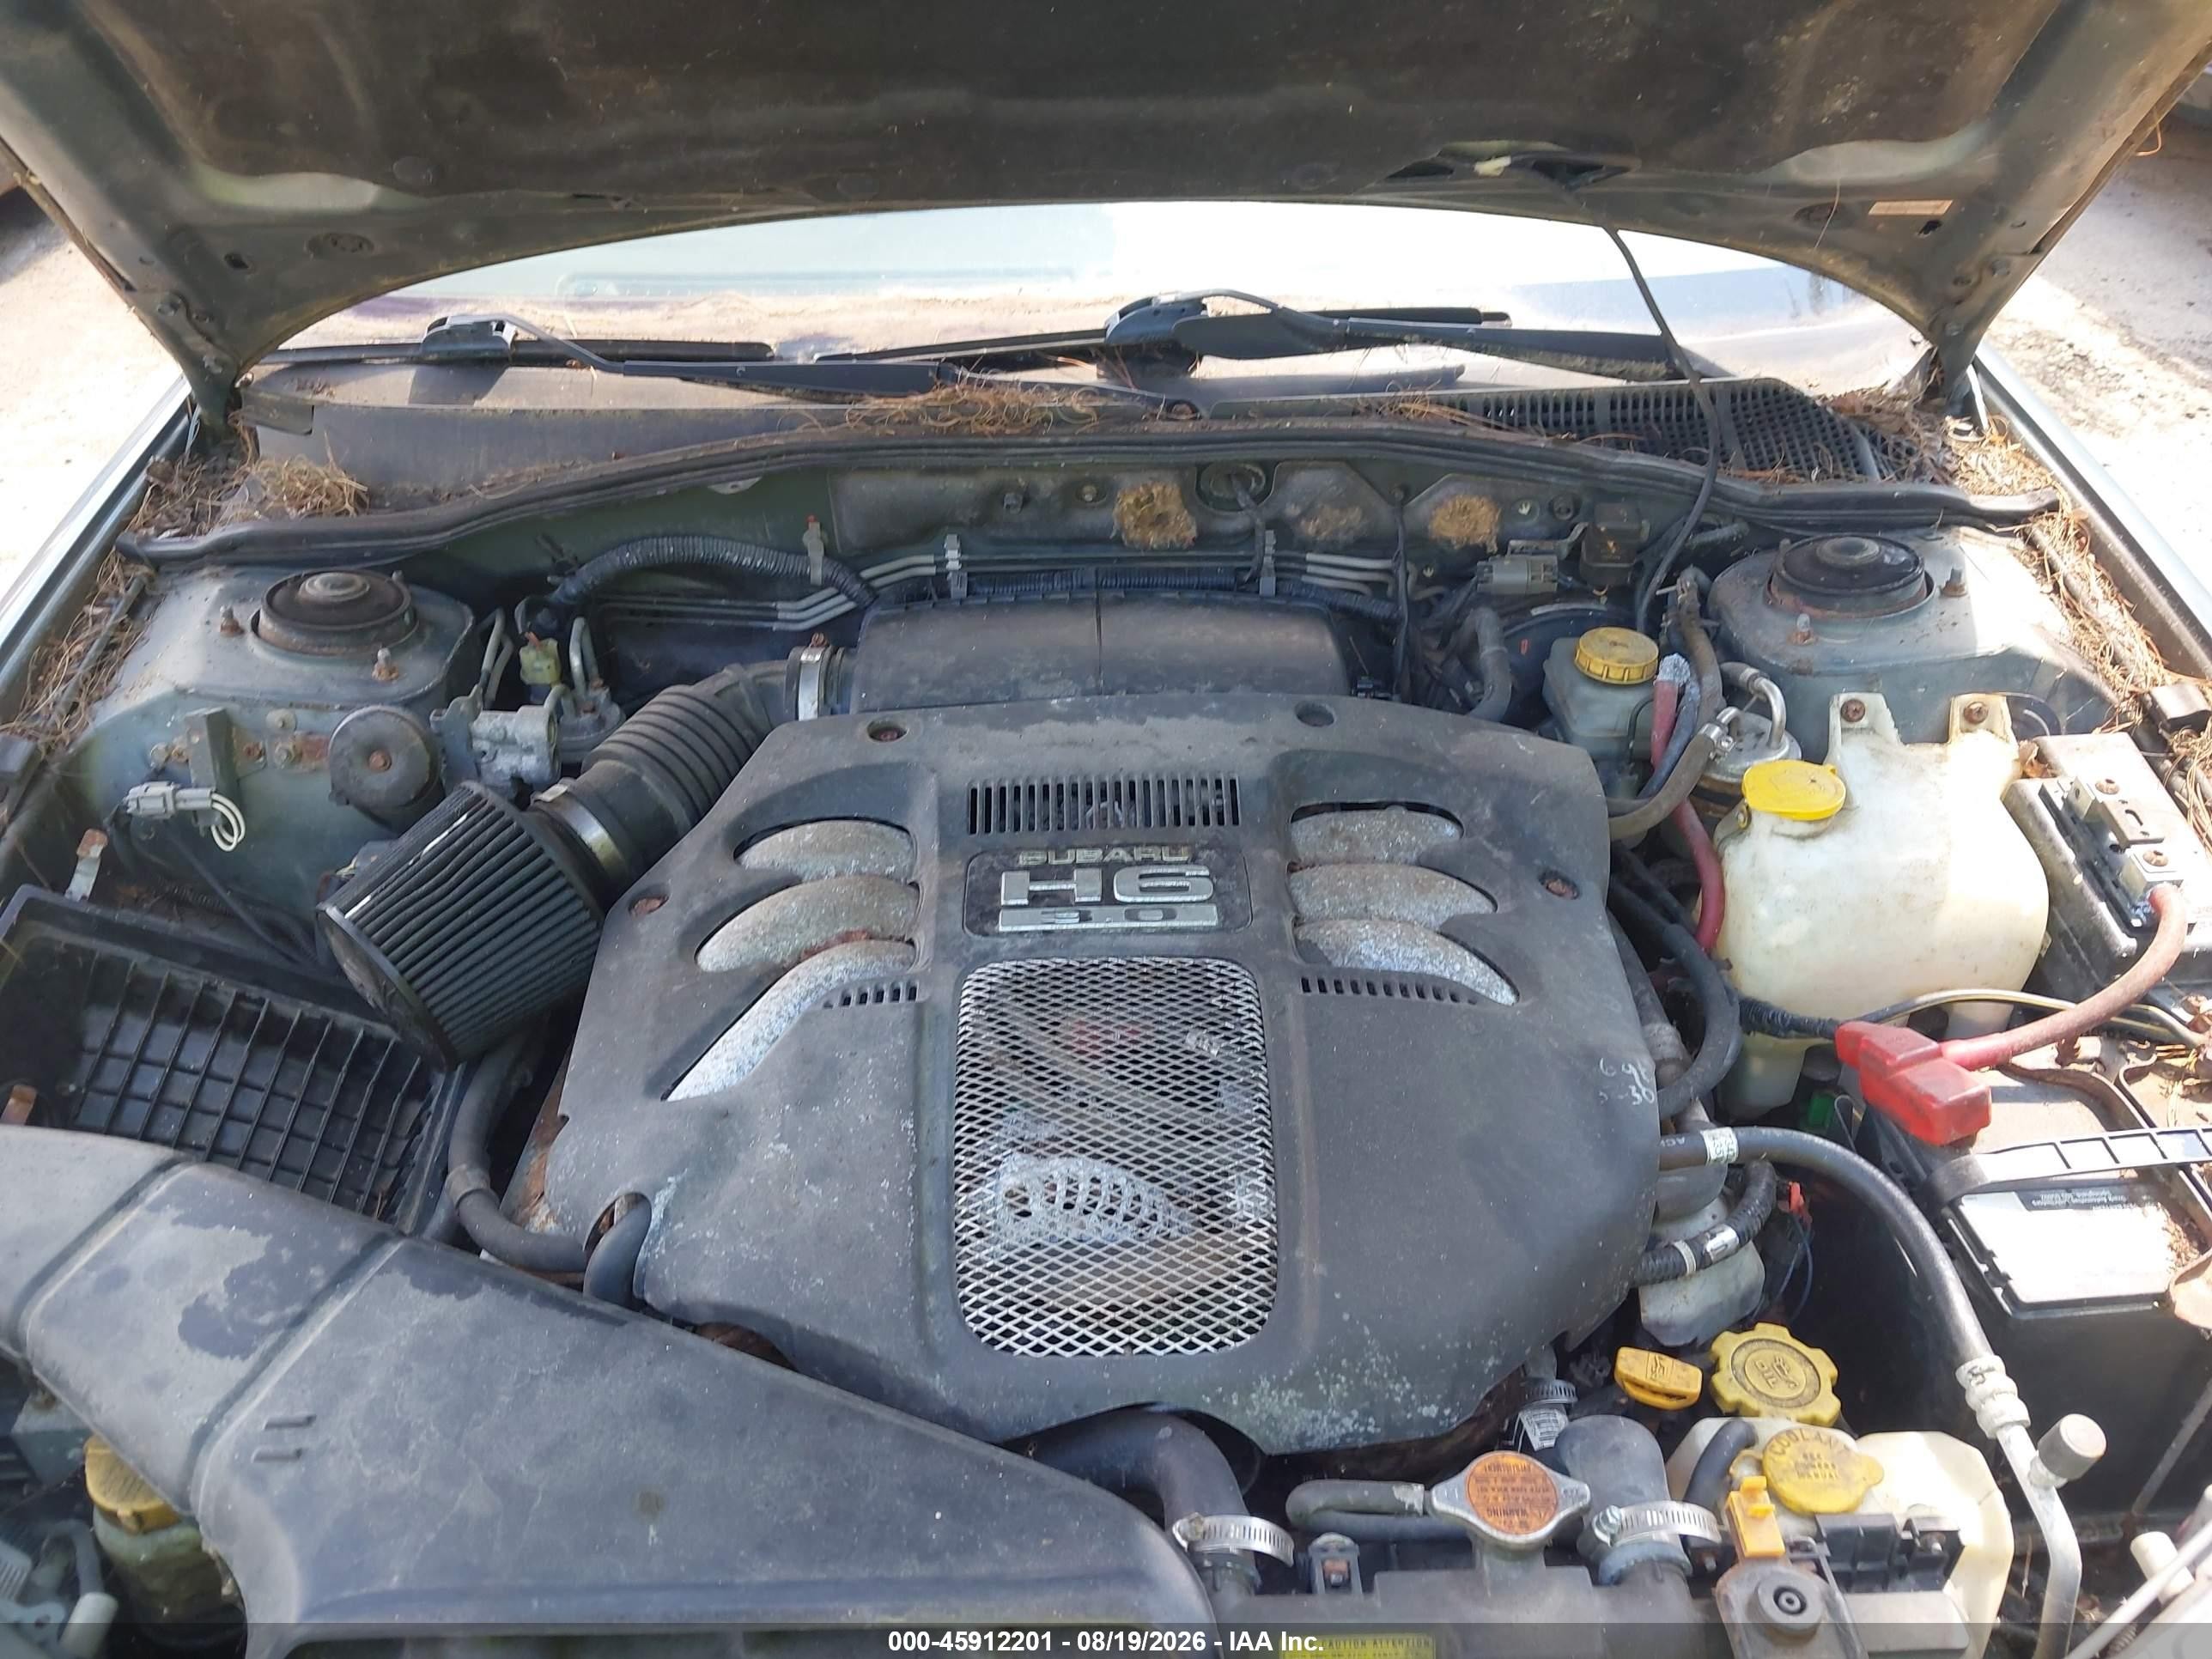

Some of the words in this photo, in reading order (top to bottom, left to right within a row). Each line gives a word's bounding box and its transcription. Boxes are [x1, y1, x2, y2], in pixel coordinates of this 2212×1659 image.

[1018, 845, 1190, 866] SUBARU
[1000, 866, 1215, 906] H6
[1755, 1360, 1776, 1389] OIL
